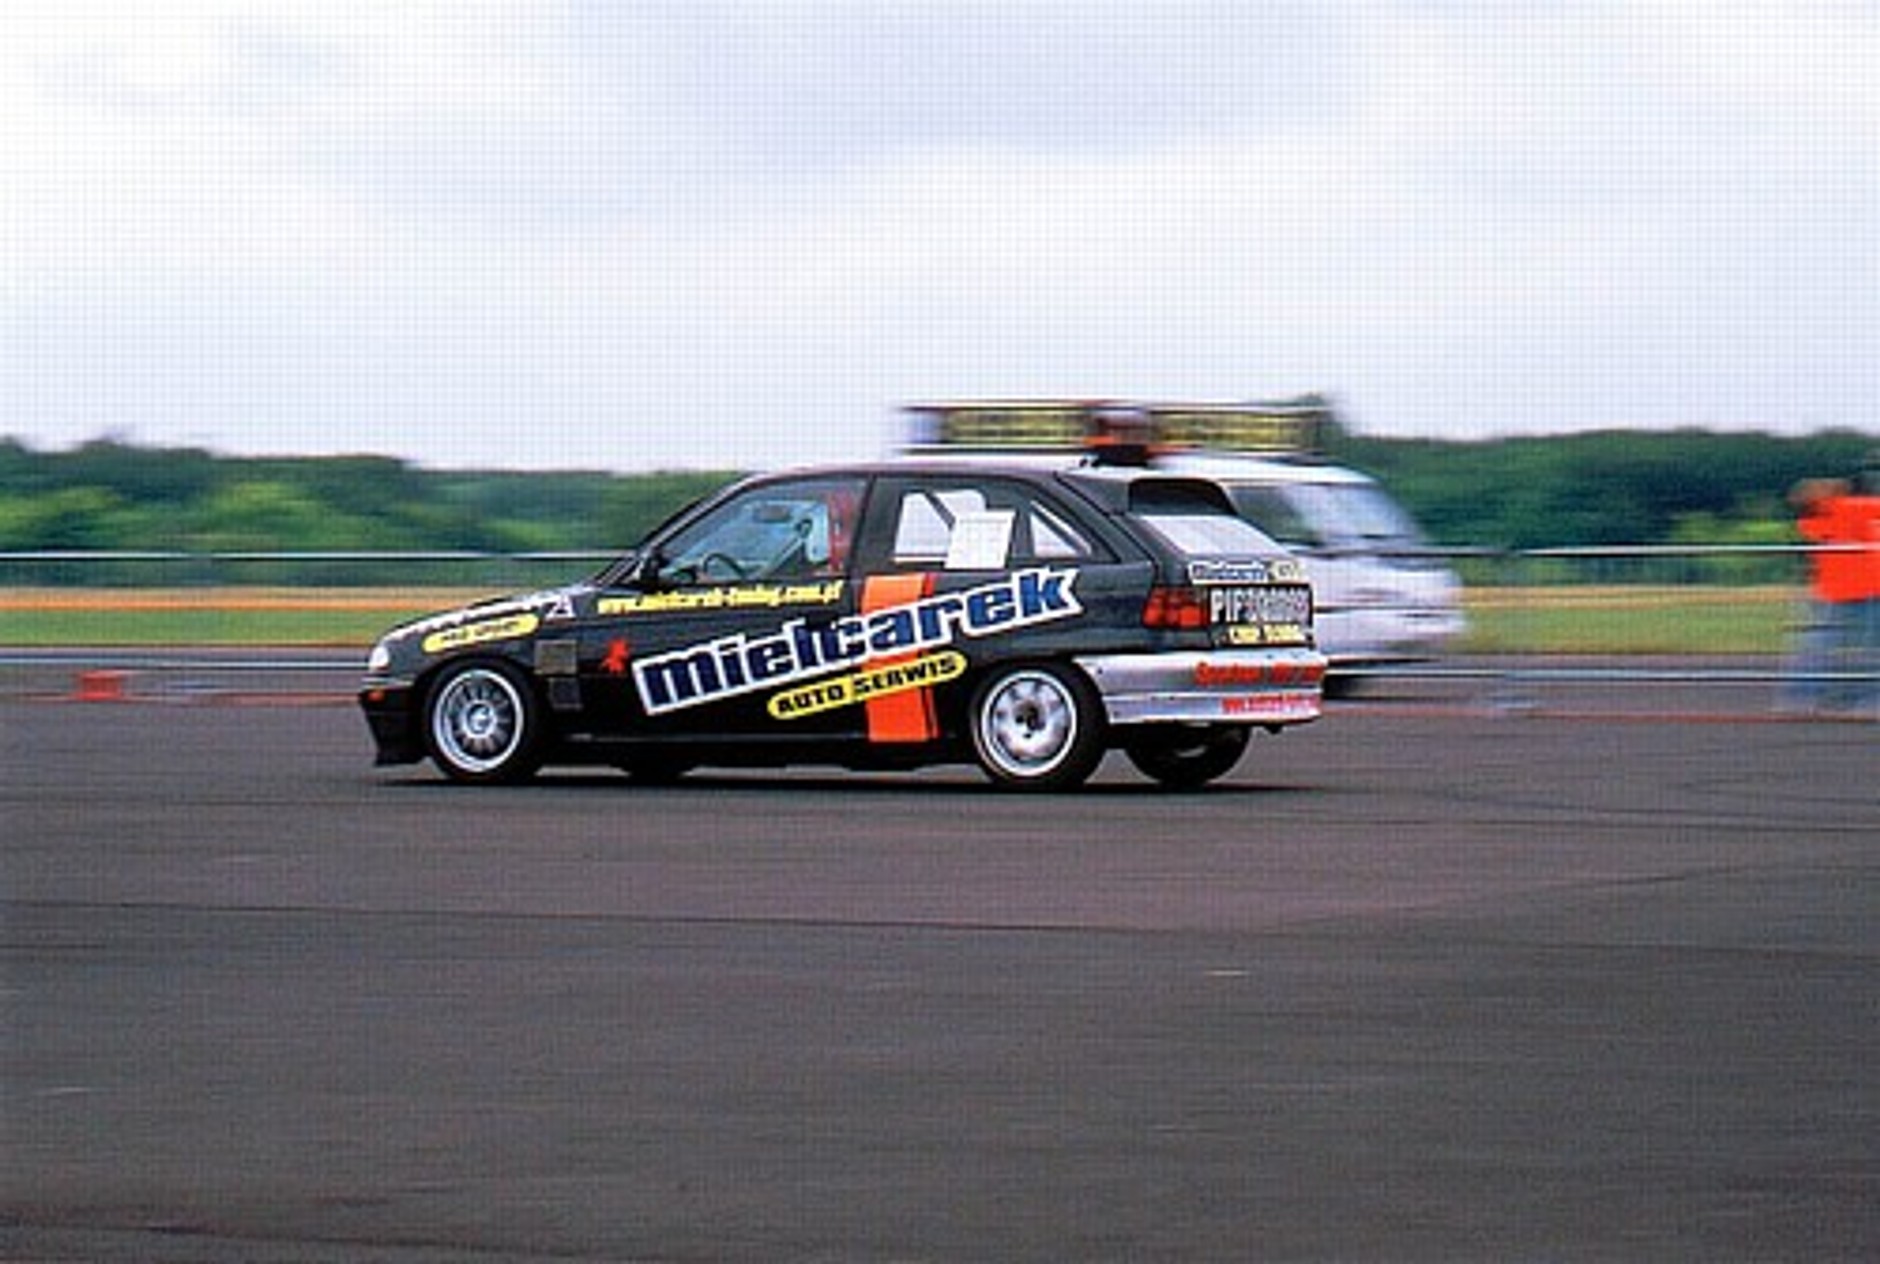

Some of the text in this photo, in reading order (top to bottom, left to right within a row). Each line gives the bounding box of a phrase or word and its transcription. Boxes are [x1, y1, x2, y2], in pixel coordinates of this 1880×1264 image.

[636, 570, 1081, 713] mielcarek
[776, 657, 957, 715] AUTO SERWIS
